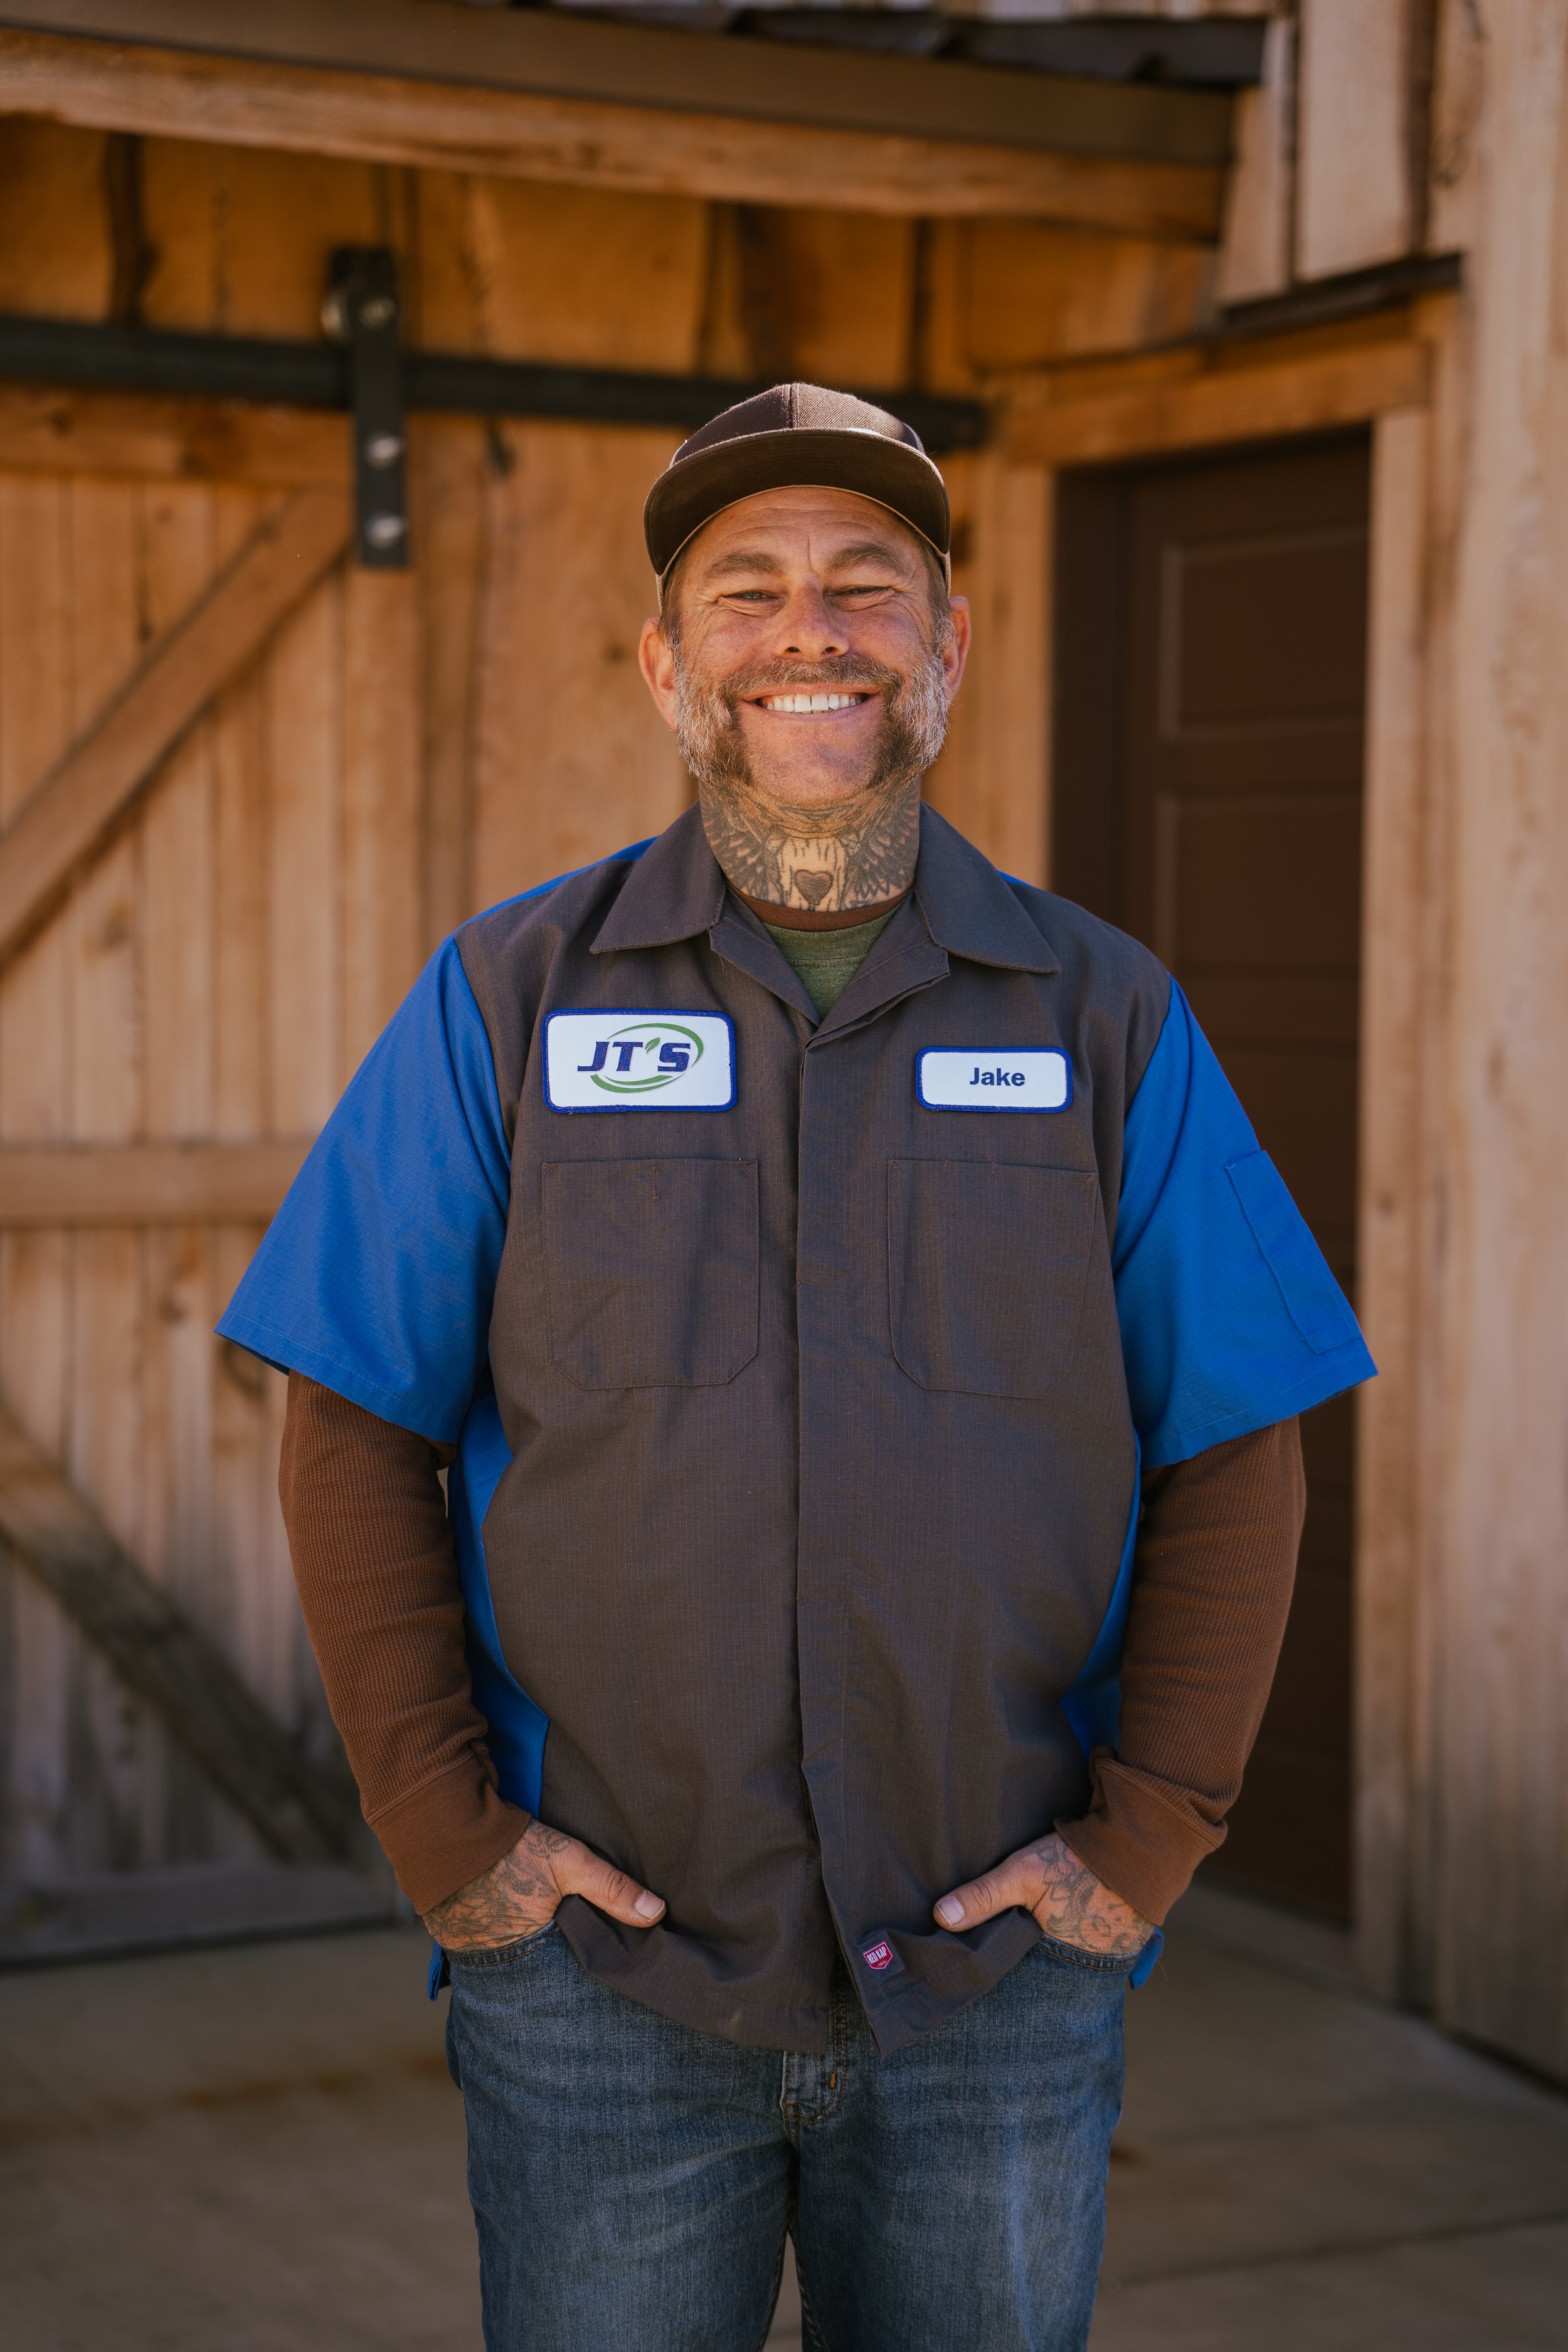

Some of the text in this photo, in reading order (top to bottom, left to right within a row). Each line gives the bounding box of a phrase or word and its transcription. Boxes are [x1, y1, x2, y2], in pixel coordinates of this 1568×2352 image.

[970, 1067, 1025, 1086] Jake
[867, 1946, 887, 1964] RED KAP
